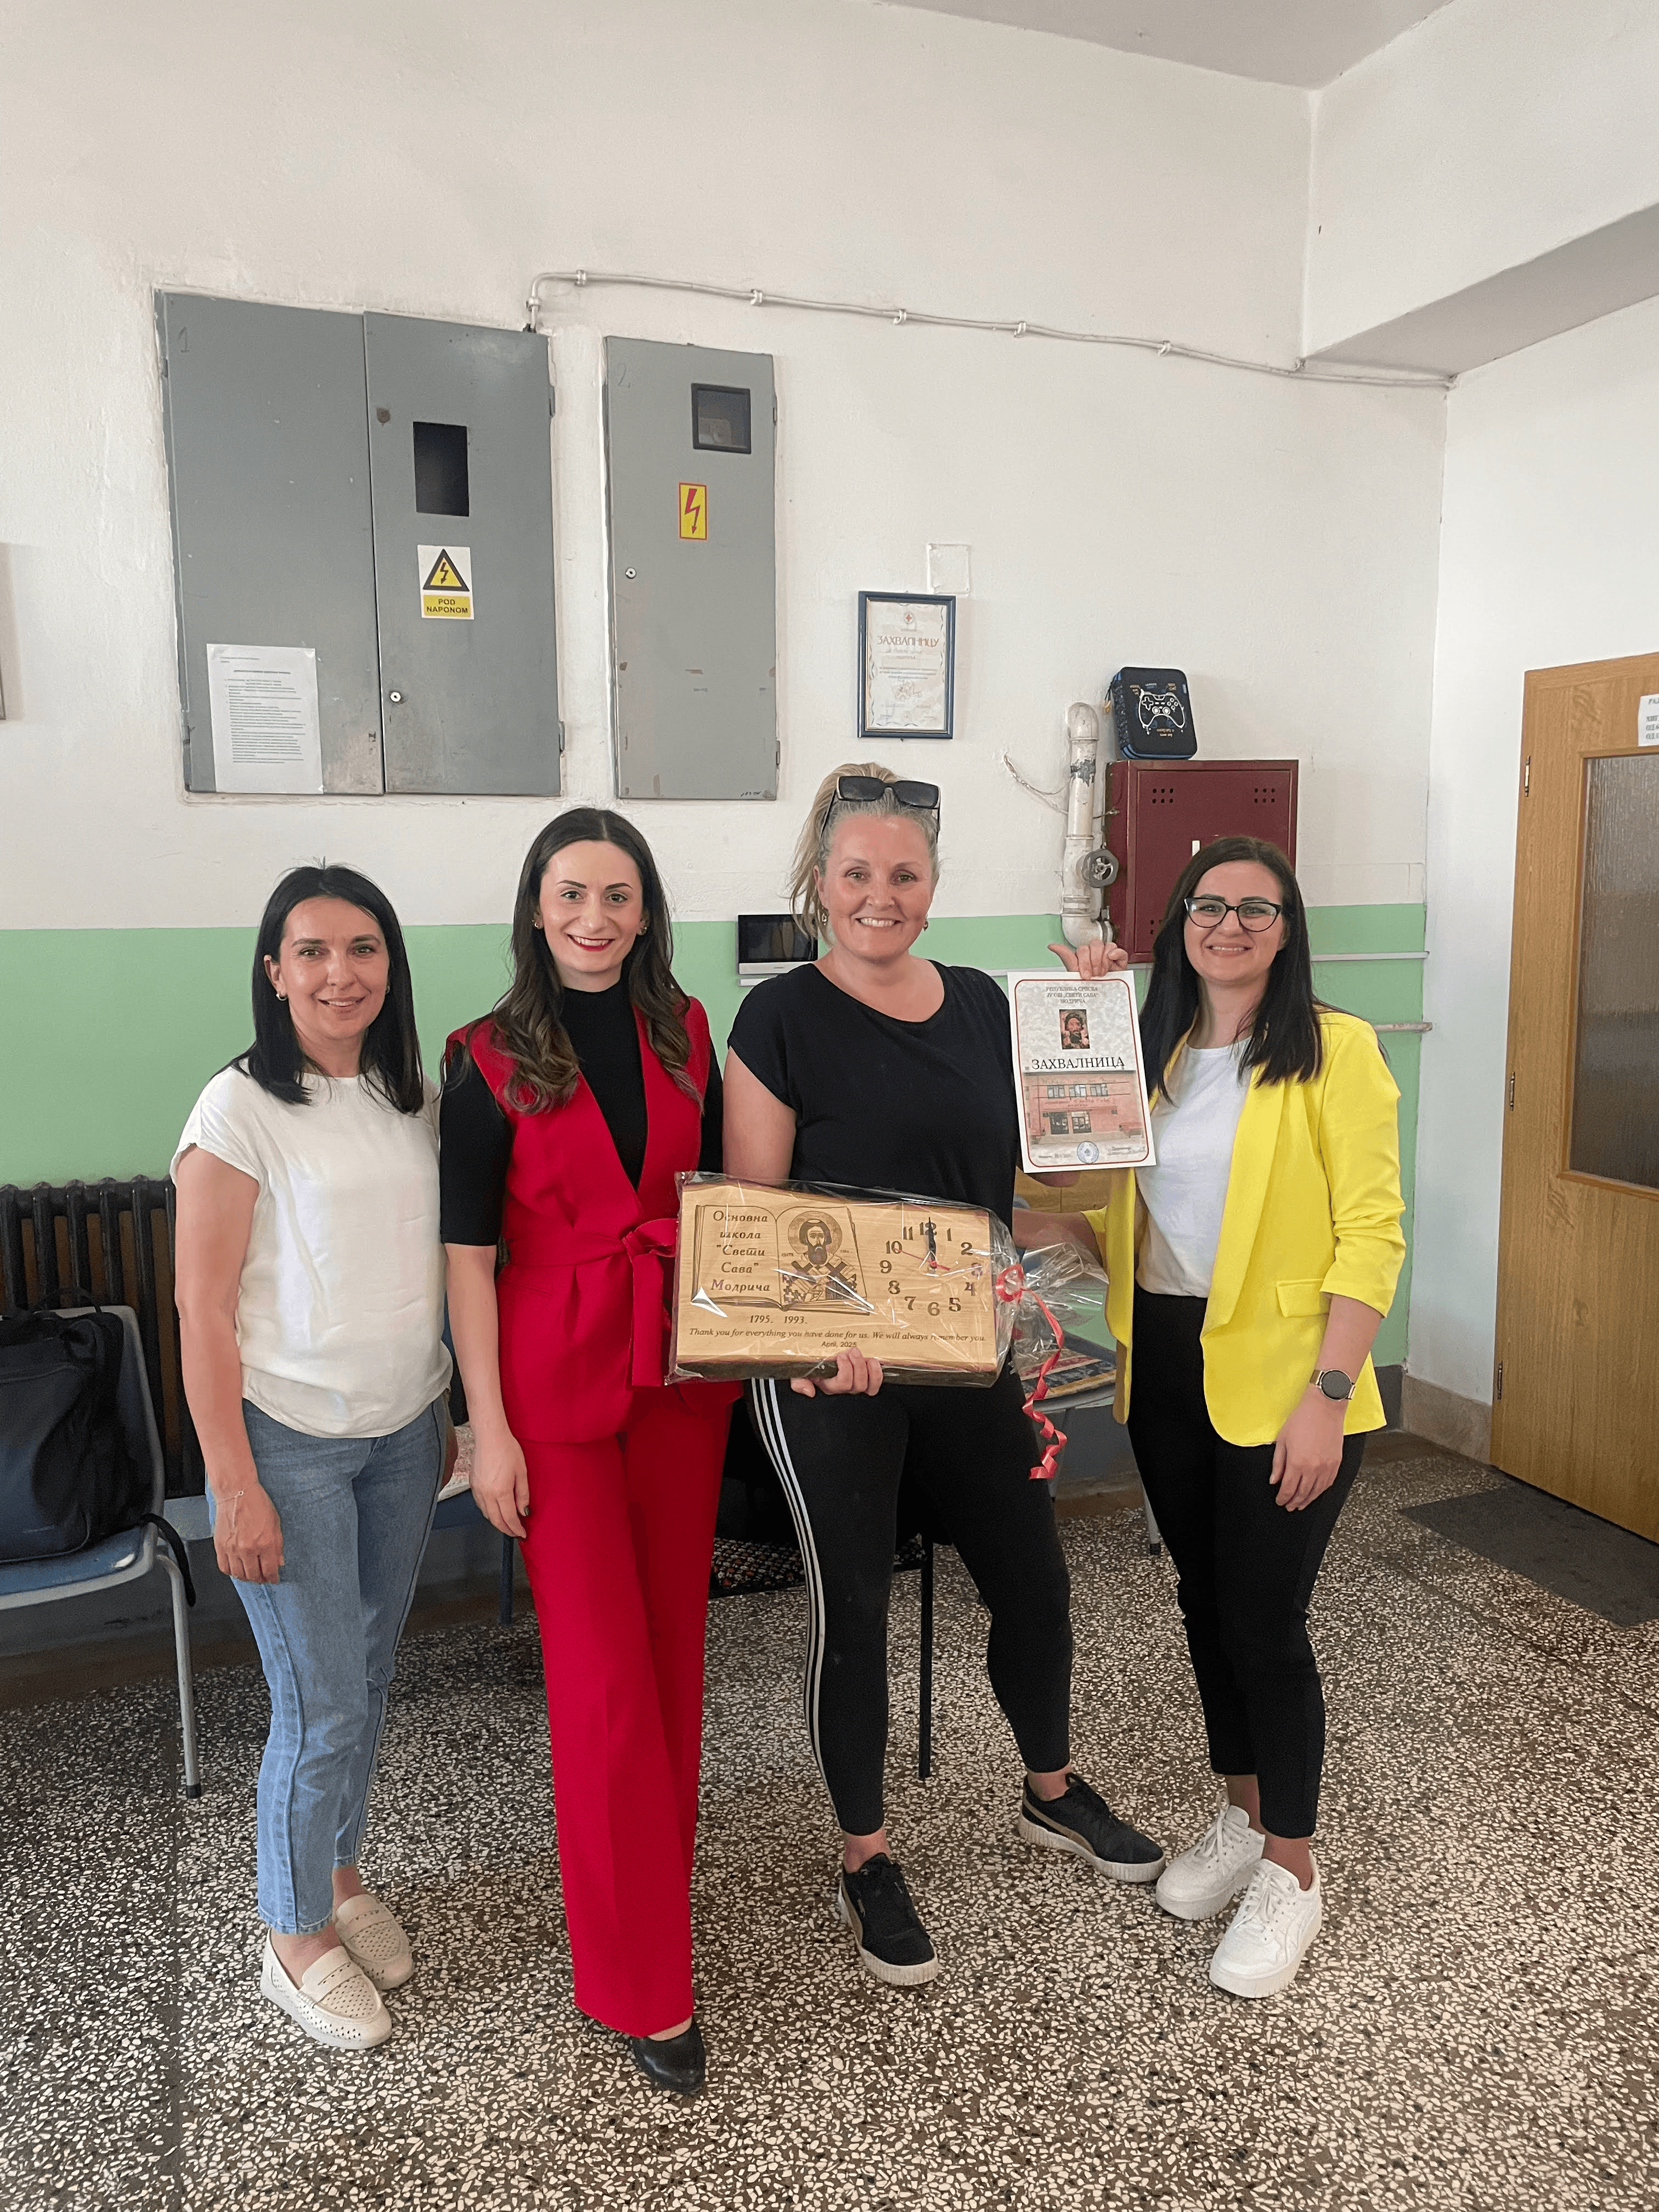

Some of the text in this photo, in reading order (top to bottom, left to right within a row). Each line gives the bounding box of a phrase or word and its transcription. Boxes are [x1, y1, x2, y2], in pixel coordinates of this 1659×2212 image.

[877, 635, 940, 648] ЗАХВАЛНИЦУ
[1031, 1057, 1125, 1070] ЗАХВАЛНИЦА
[713, 1210, 768, 1222] Основна
[719, 1231, 761, 1239] школа
[903, 1226, 913, 1240] 11
[946, 1228, 952, 1242] 1
[885, 1240, 902, 1254] 10
[961, 1242, 973, 1256] 2
[721, 1262, 759, 1273] Сава"
[879, 1260, 892, 1274] 9
[710, 1279, 770, 1294] Модрича
[888, 1280, 901, 1295] 8
[964, 1282, 975, 1296] 4
[904, 1296, 917, 1311] 7
[927, 1302, 940, 1316] 6
[949, 1297, 962, 1312] 5
[749, 1314, 808, 1324] 1795. 1993.
[689, 1328, 714, 1336] Thank
[730, 1328, 744, 1338] for
[745, 1329, 786, 1338] everything
[844, 1330, 857, 1340] for
[902, 1332, 928, 1342] always
